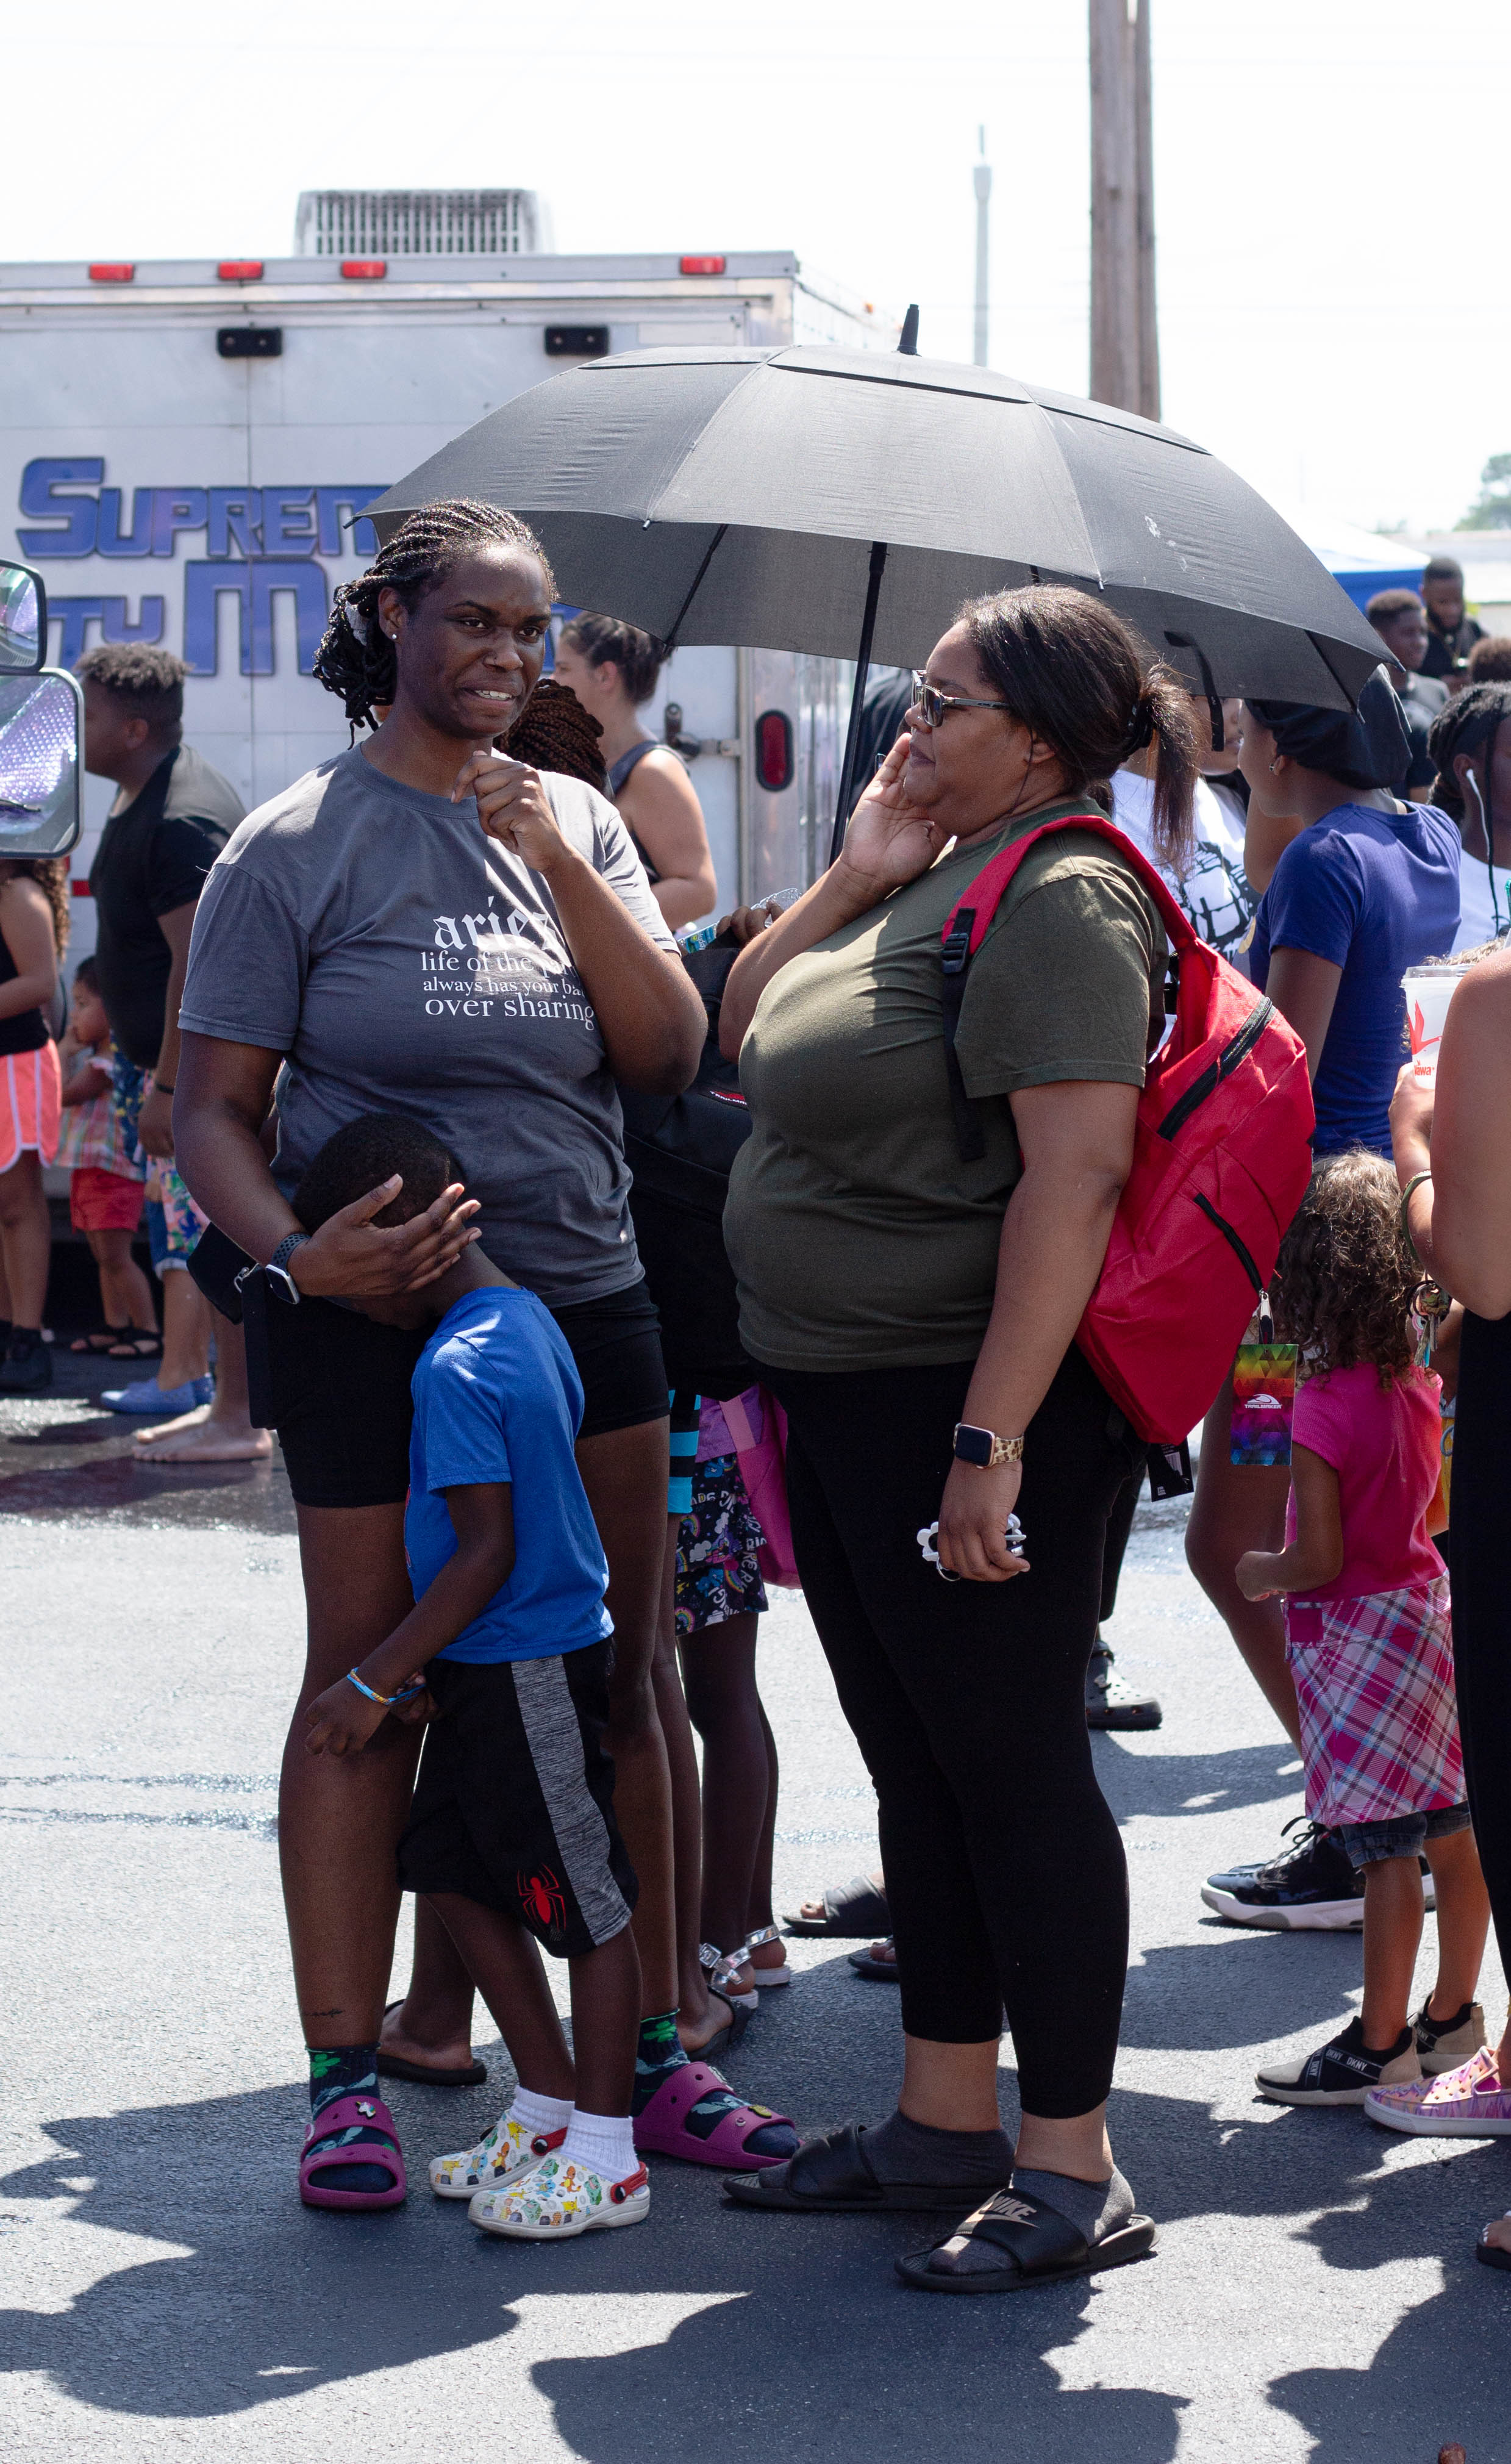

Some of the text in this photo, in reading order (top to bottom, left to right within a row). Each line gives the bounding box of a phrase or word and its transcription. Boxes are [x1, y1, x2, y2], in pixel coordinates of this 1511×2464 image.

[16, 457, 393, 557] SUPREM
[421, 950, 460, 971] life
[466, 951, 490, 972] of
[495, 951, 534, 972] the
[423, 976, 585, 998] always has your ba
[425, 992, 595, 1031] over sharing
[1346, 2056, 1367, 2072] DKNY
[987, 2196, 1037, 2217] NIKE
